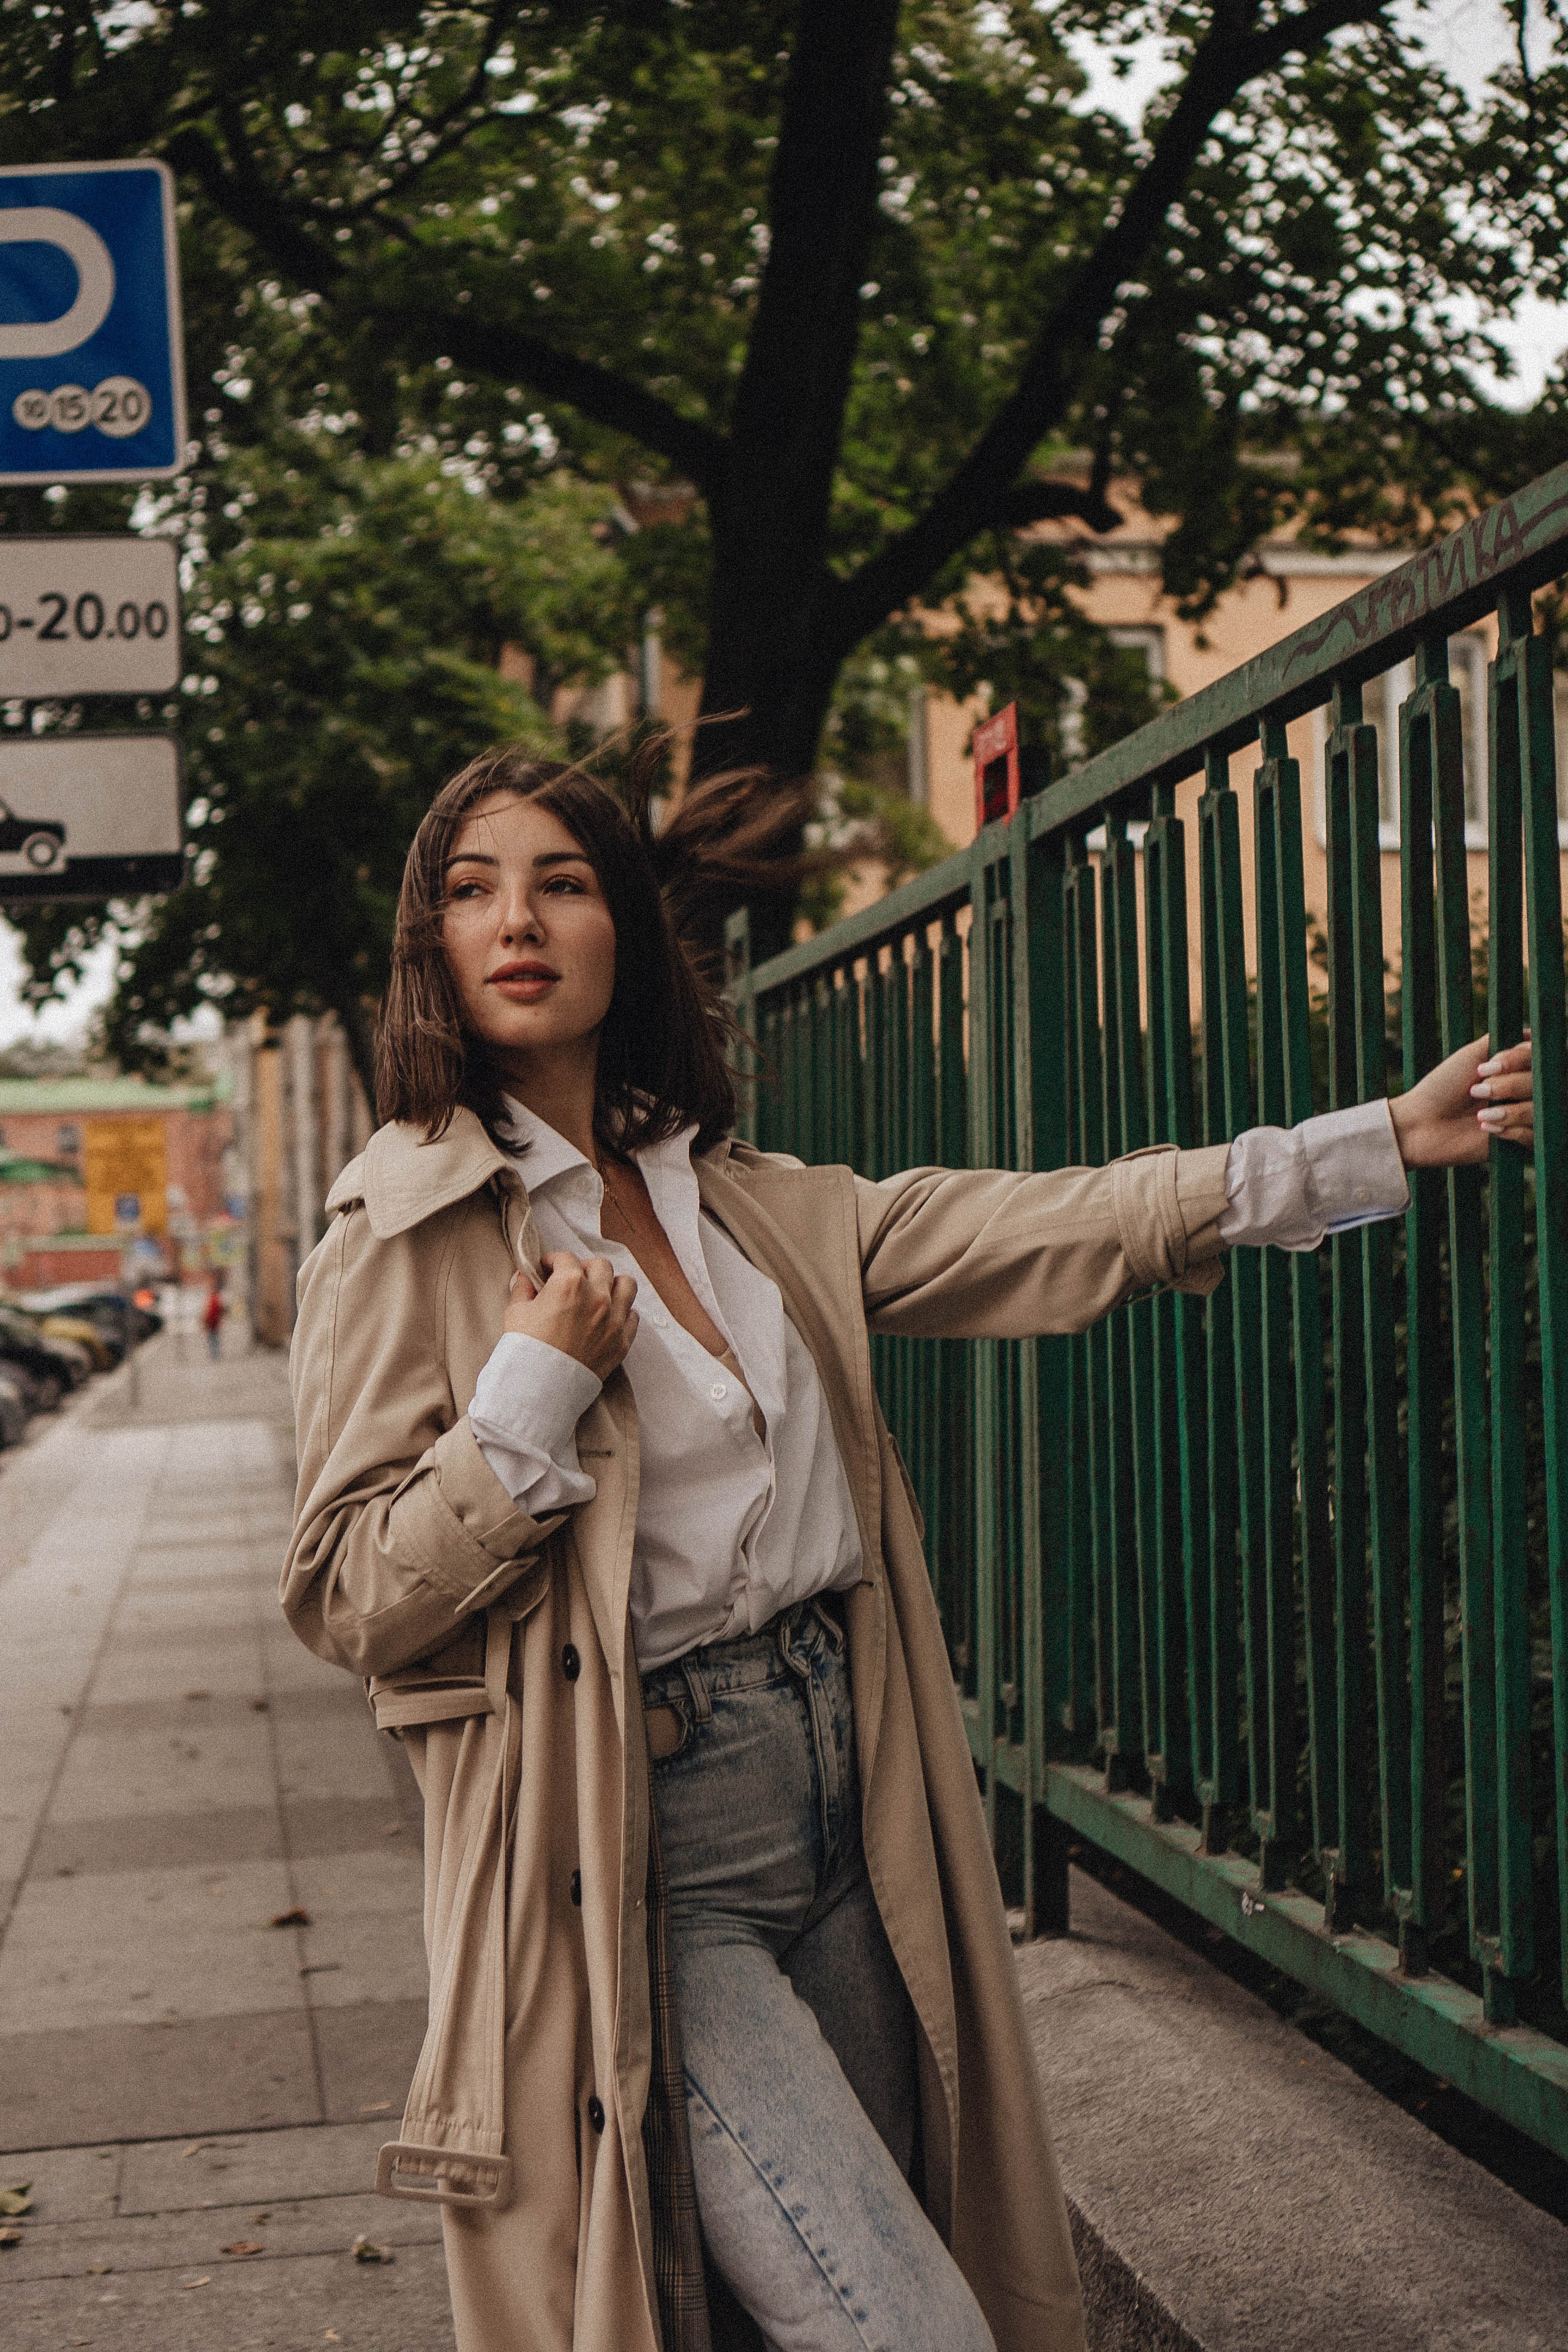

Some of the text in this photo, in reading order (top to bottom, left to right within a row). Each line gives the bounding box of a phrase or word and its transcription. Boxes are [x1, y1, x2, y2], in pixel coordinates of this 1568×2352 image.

[22, 390, 143, 423] 10 15 20
